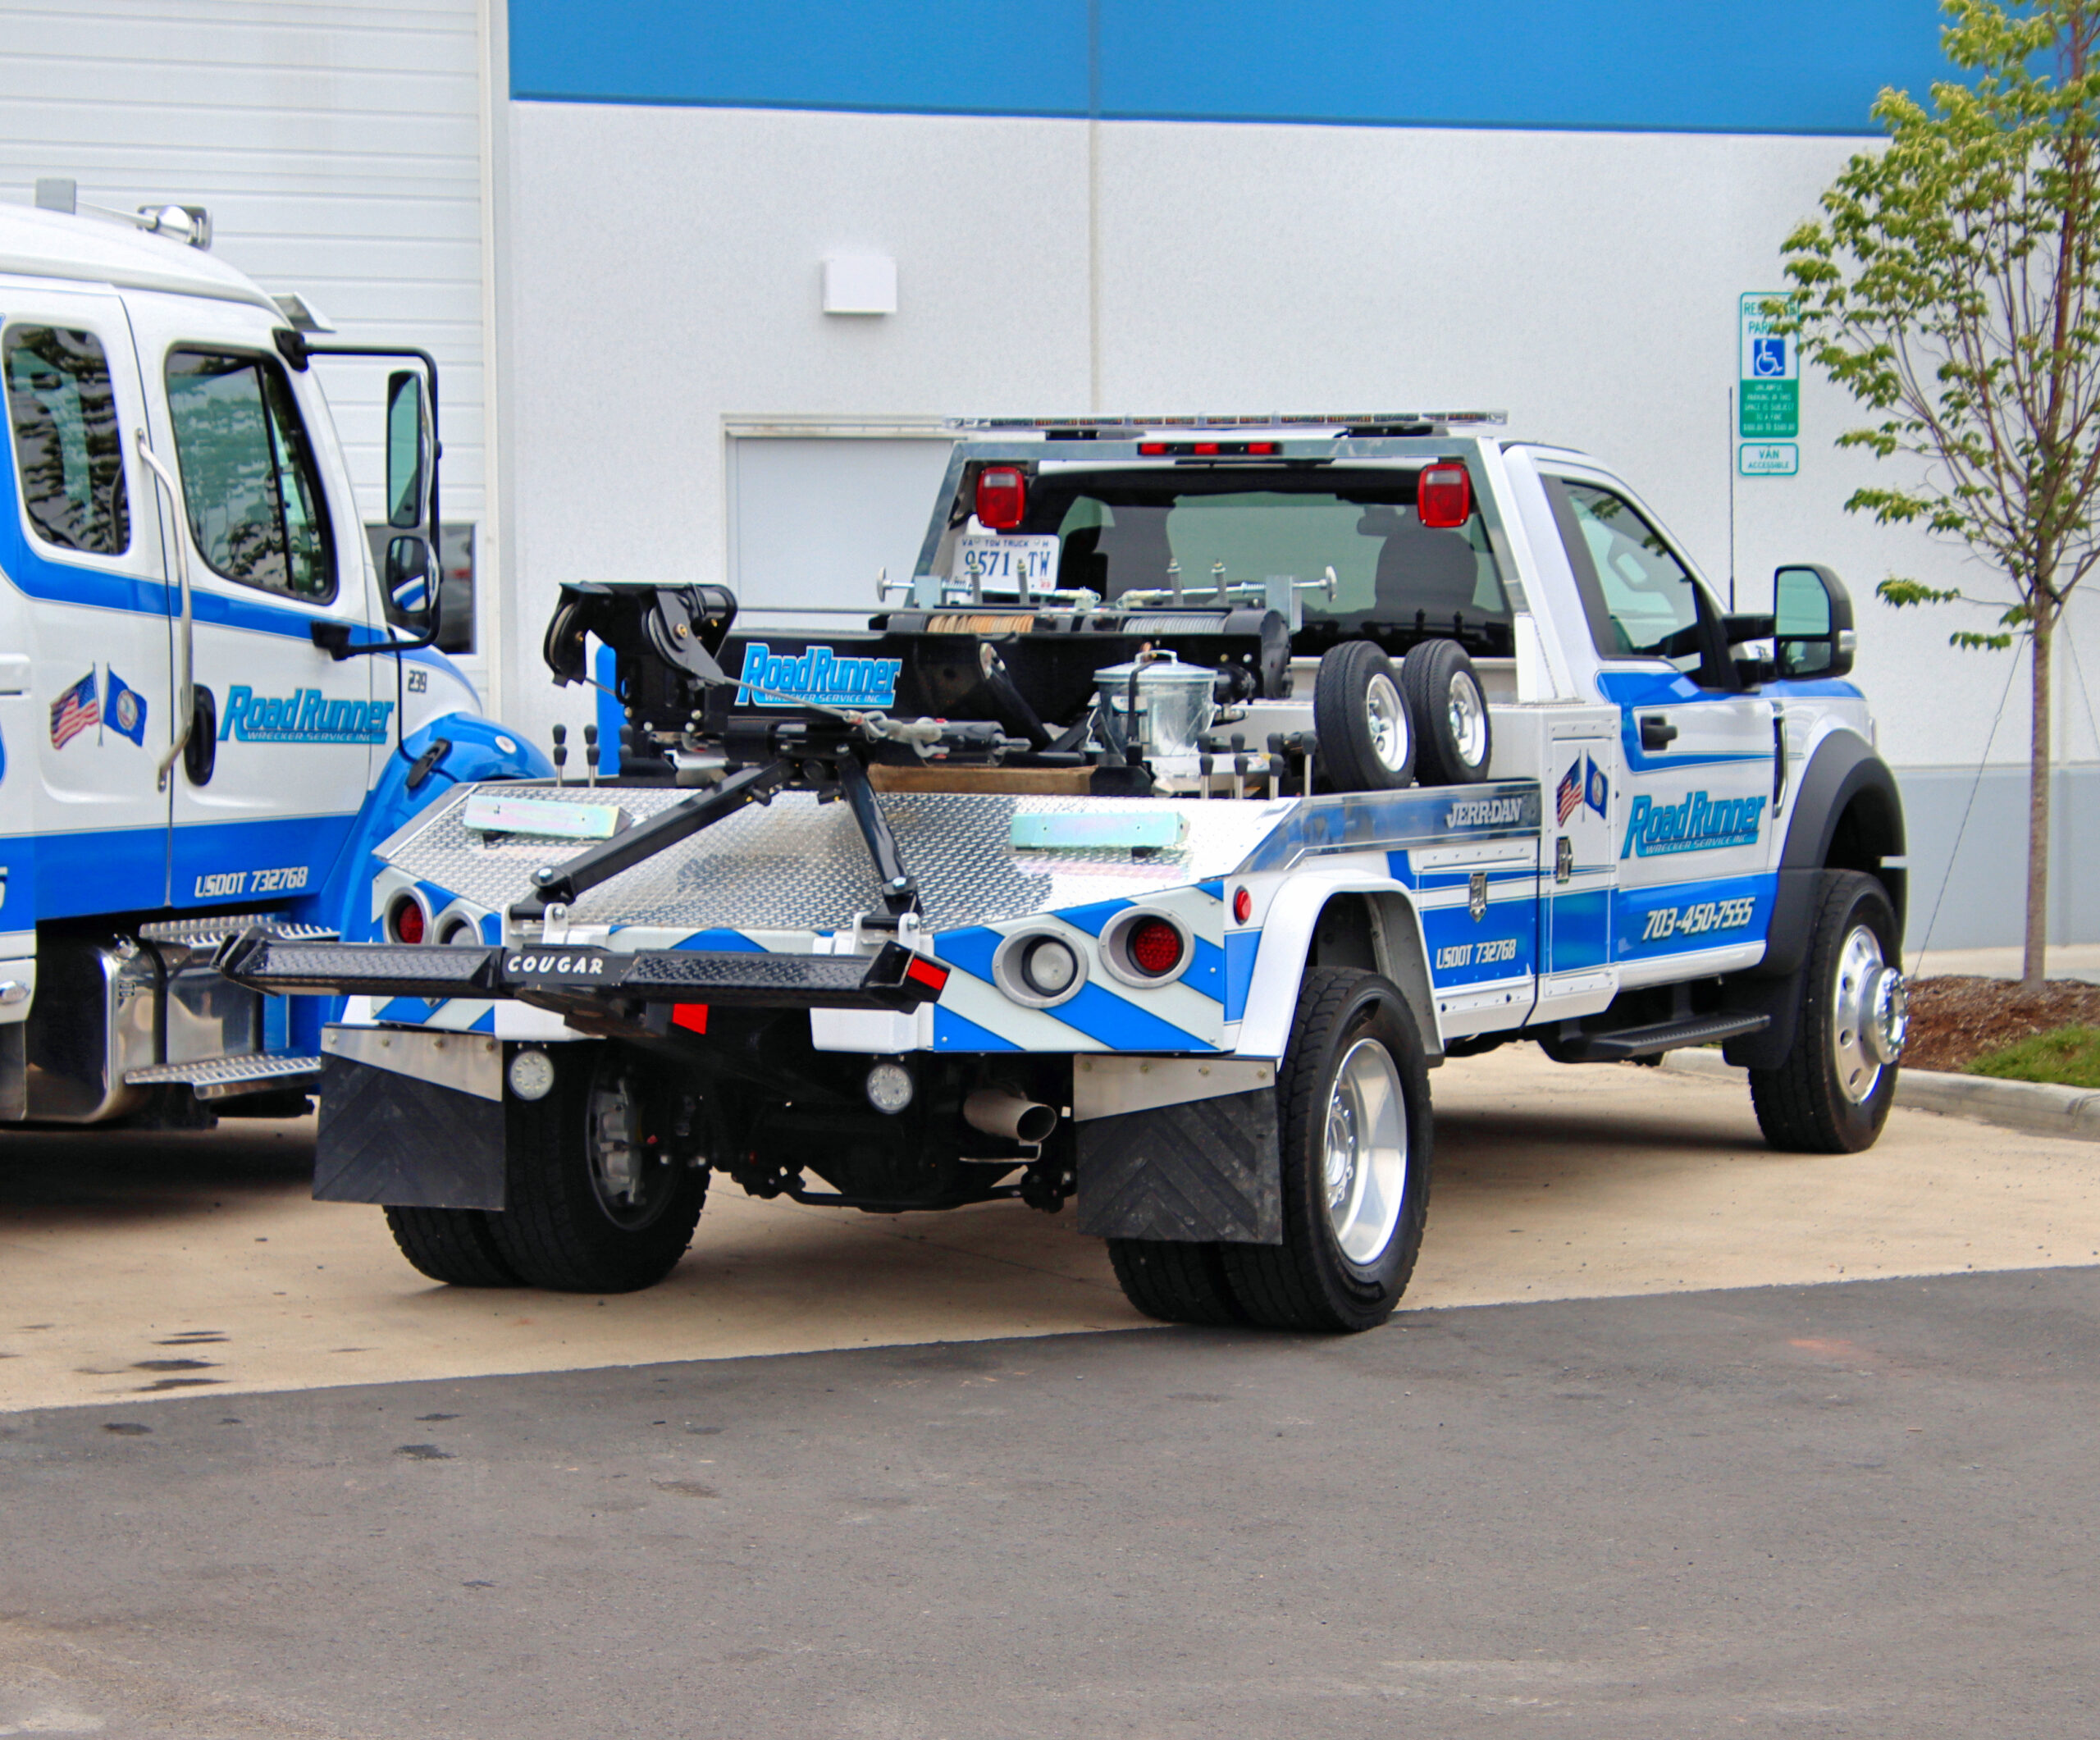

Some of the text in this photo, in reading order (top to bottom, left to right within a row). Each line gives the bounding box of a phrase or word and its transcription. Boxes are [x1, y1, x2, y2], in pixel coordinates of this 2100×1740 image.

[1747, 461, 1789, 469] ACCESSIBLE
[1759, 449, 1780, 459] VAN
[961, 538, 974, 546] VA
[1003, 539, 1029, 547] TRUCK
[964, 550, 1051, 577] 9571 TW
[408, 669, 427, 693] 239
[734, 642, 902, 706] RoadRunner
[819, 693, 862, 703] SERVICE
[217, 684, 395, 742] RoadRunner
[248, 731, 305, 741] WRECKER
[307, 732, 353, 742] SERVICE
[1620, 791, 1768, 860] RoadRunner
[1646, 840, 1692, 854] WRECKER
[1694, 835, 1732, 848] SERVICE
[194, 865, 308, 898] USDOT 732768
[1641, 896, 1755, 941] 703-450-7555
[507, 955, 604, 975] COUGAR
[1436, 938, 1518, 970] USDOT 732768
